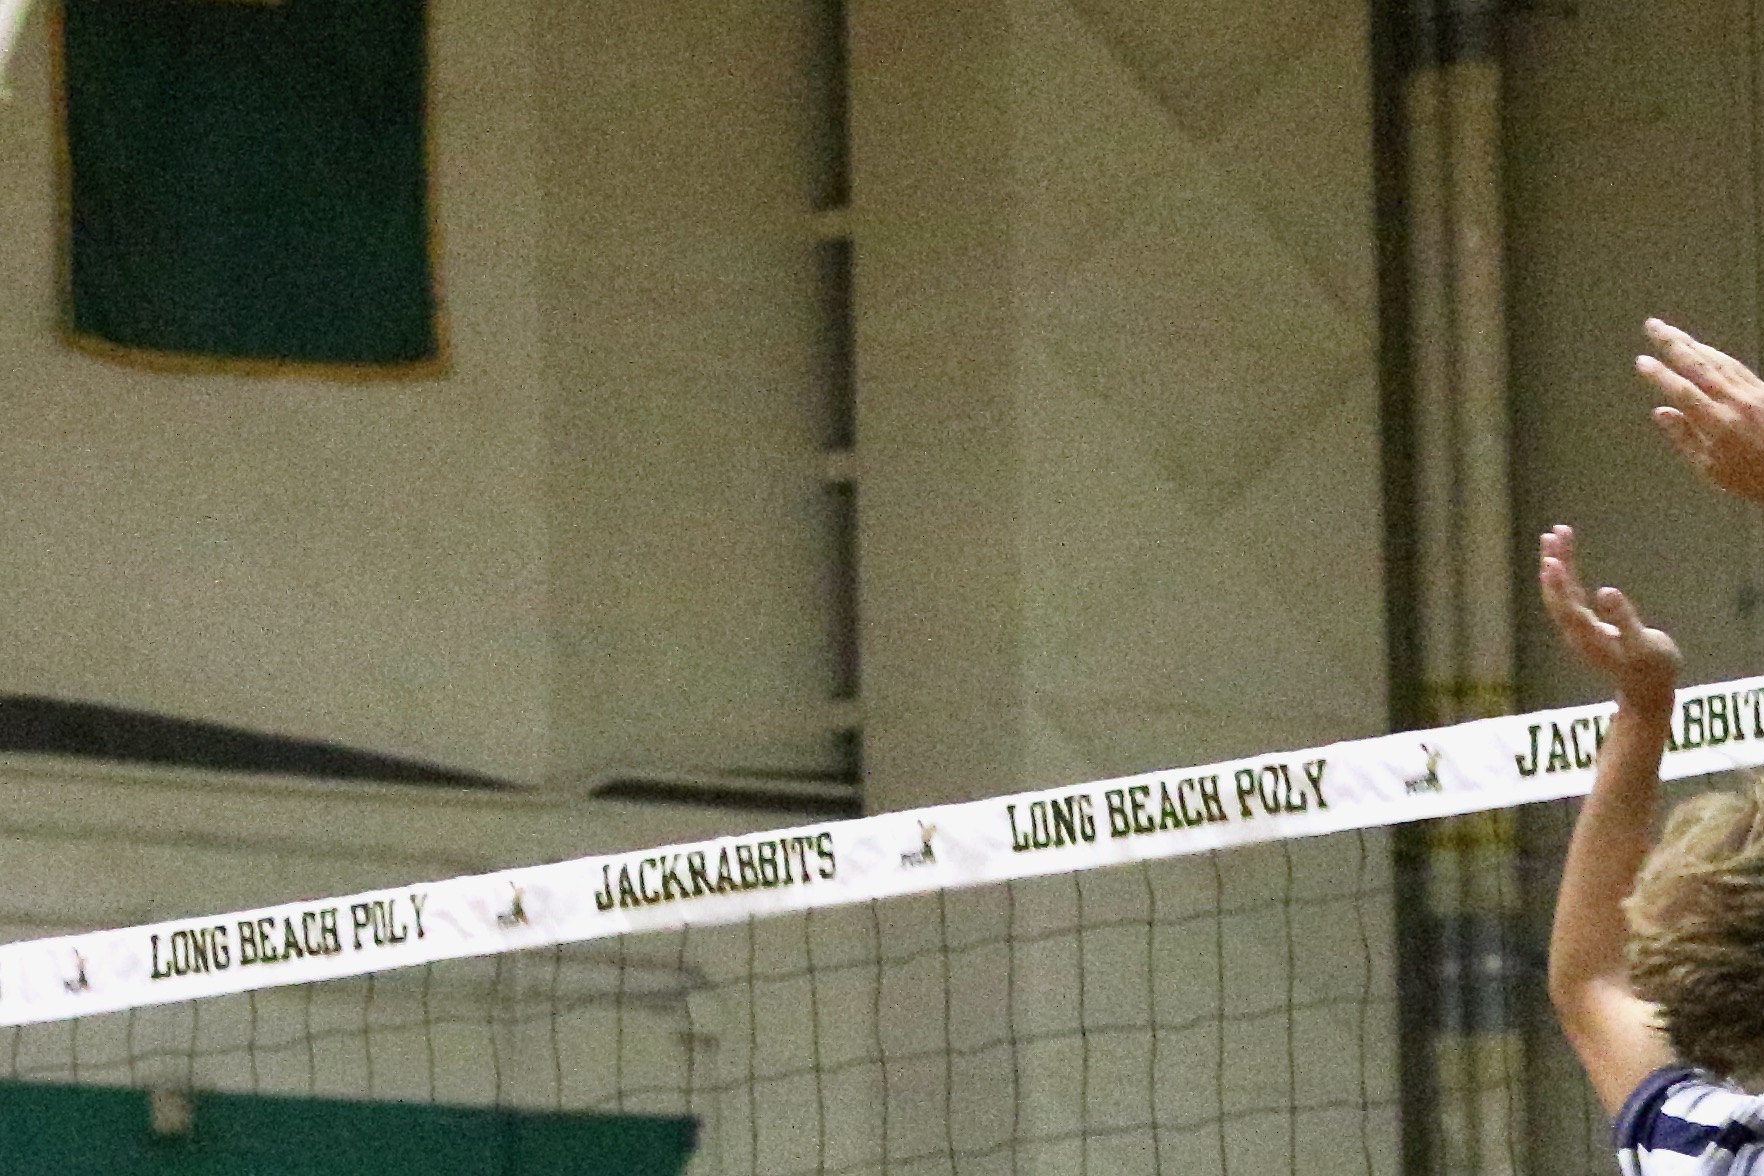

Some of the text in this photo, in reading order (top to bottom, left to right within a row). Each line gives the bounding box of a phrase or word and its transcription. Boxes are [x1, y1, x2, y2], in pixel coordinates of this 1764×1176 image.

[1007, 759, 1329, 853] LONG BEACH POLY
[595, 831, 837, 912] JACKRABBITS
[150, 893, 430, 982] LONG BEACH POLY
